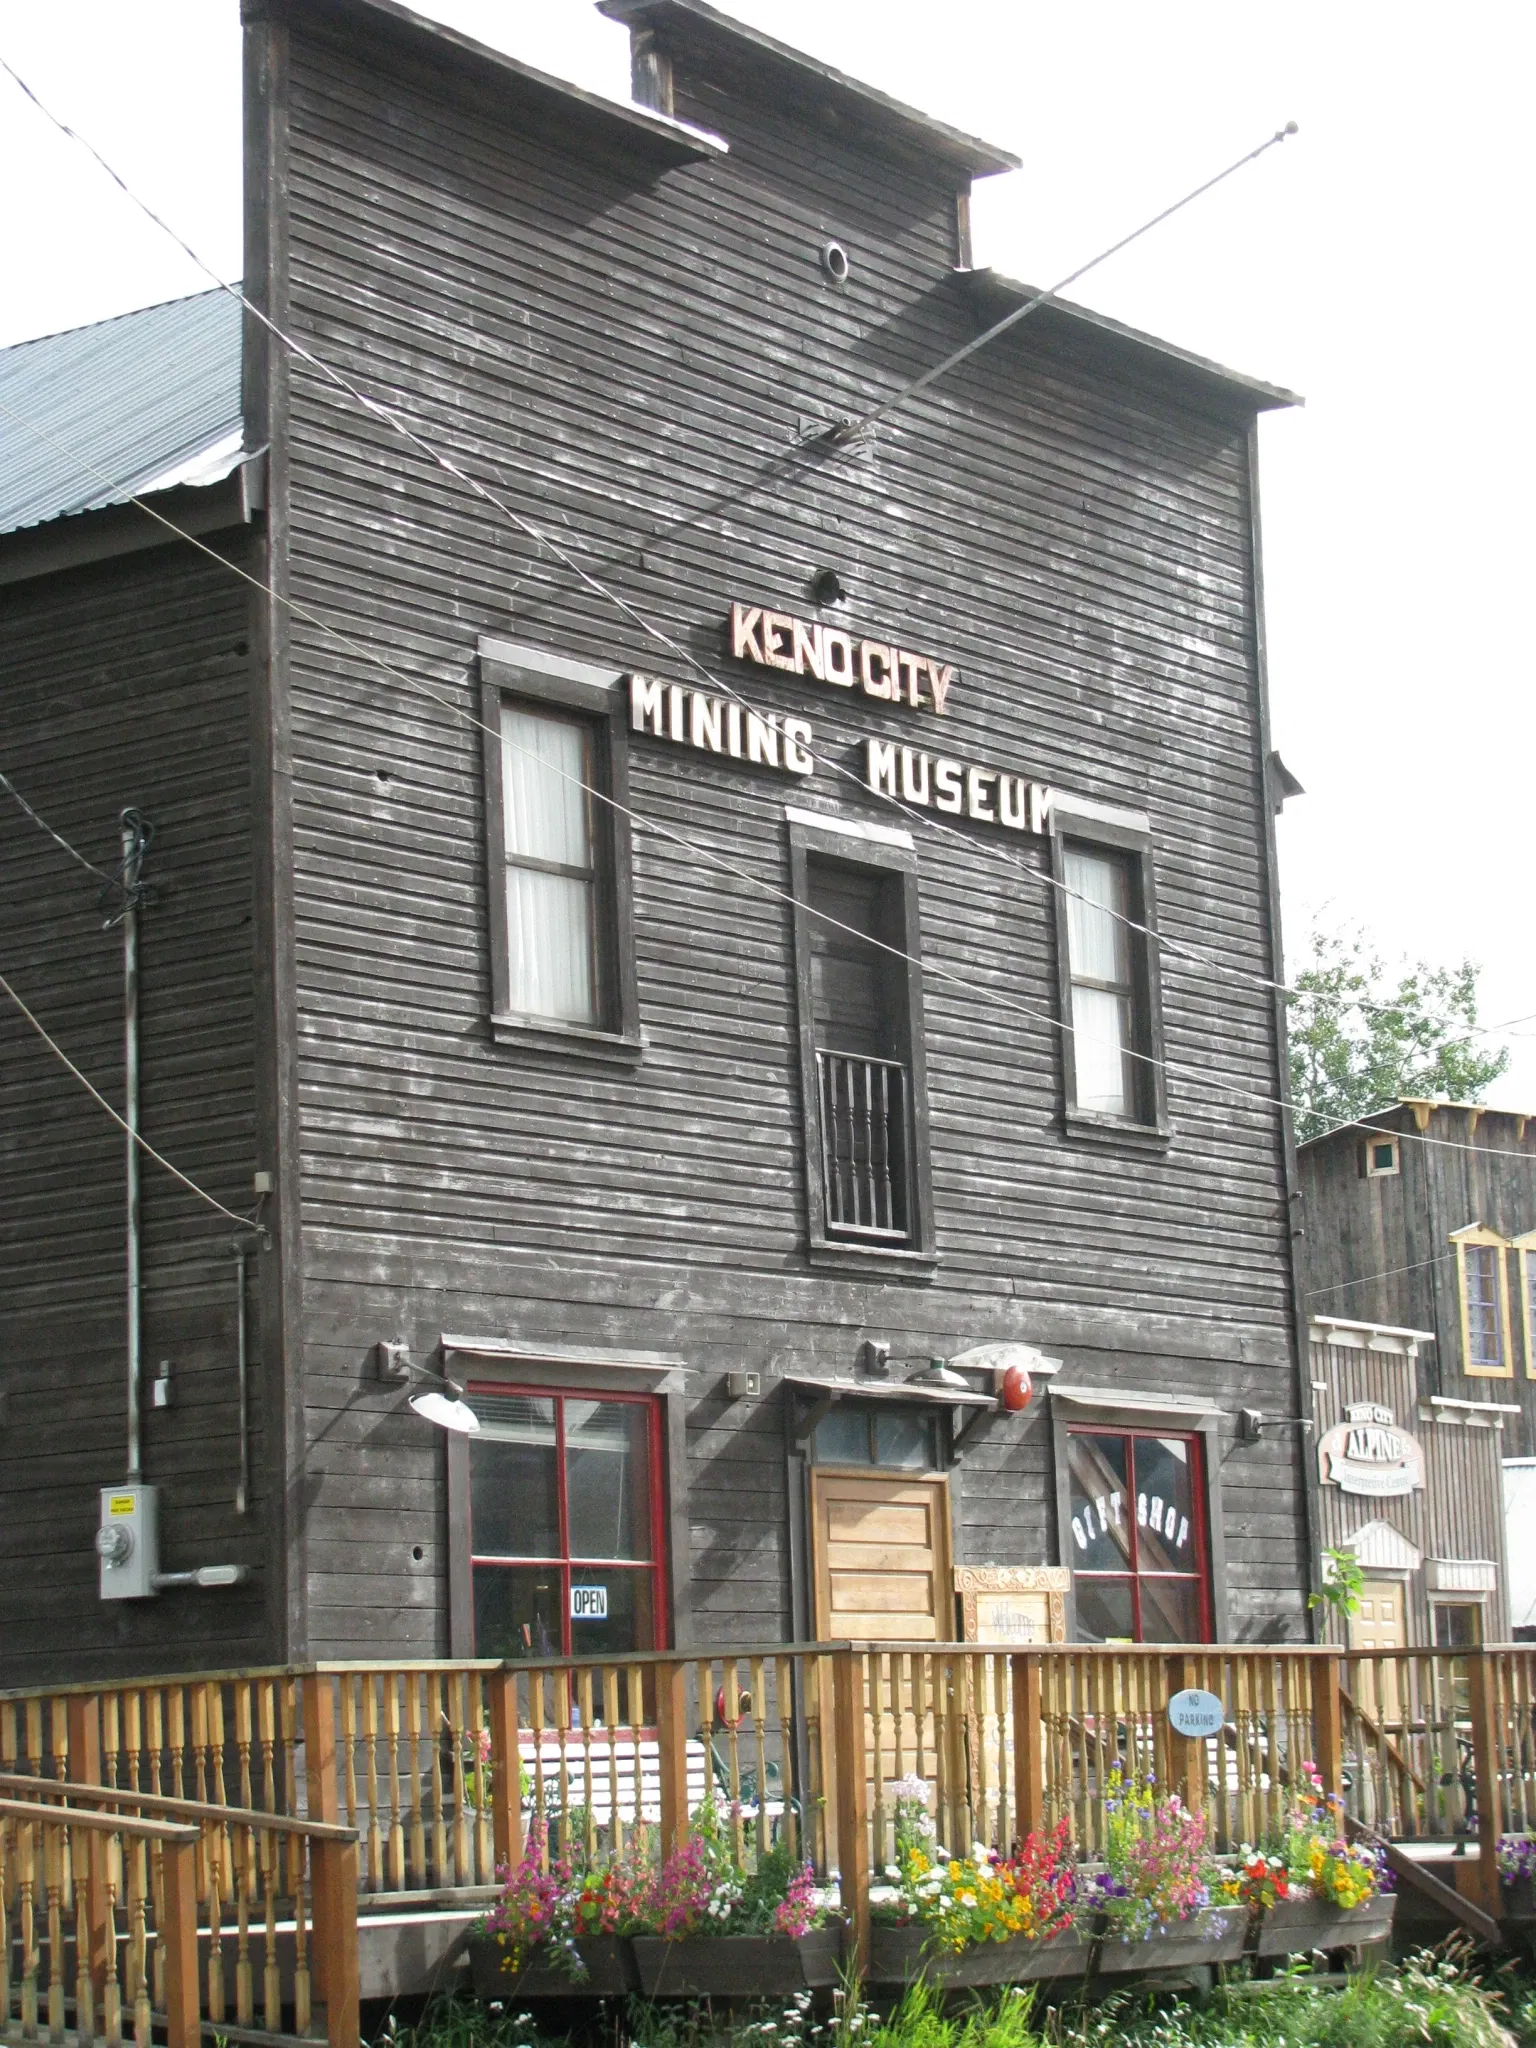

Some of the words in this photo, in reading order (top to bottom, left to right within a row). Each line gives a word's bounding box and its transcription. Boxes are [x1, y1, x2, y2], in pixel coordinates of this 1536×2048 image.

[729, 601, 854, 688] KENO
[860, 638, 954, 715] CITY
[629, 674, 814, 776] MINING
[866, 739, 1055, 836] MUSEUM
[1347, 1427, 1402, 1462] ALPINE
[1072, 1491, 1121, 1549] GIFT
[1137, 1492, 1189, 1549] SHOP
[573, 1589, 605, 1614] OPEN
[1188, 1694, 1200, 1707] NO
[1179, 1712, 1214, 1726] PARKING
